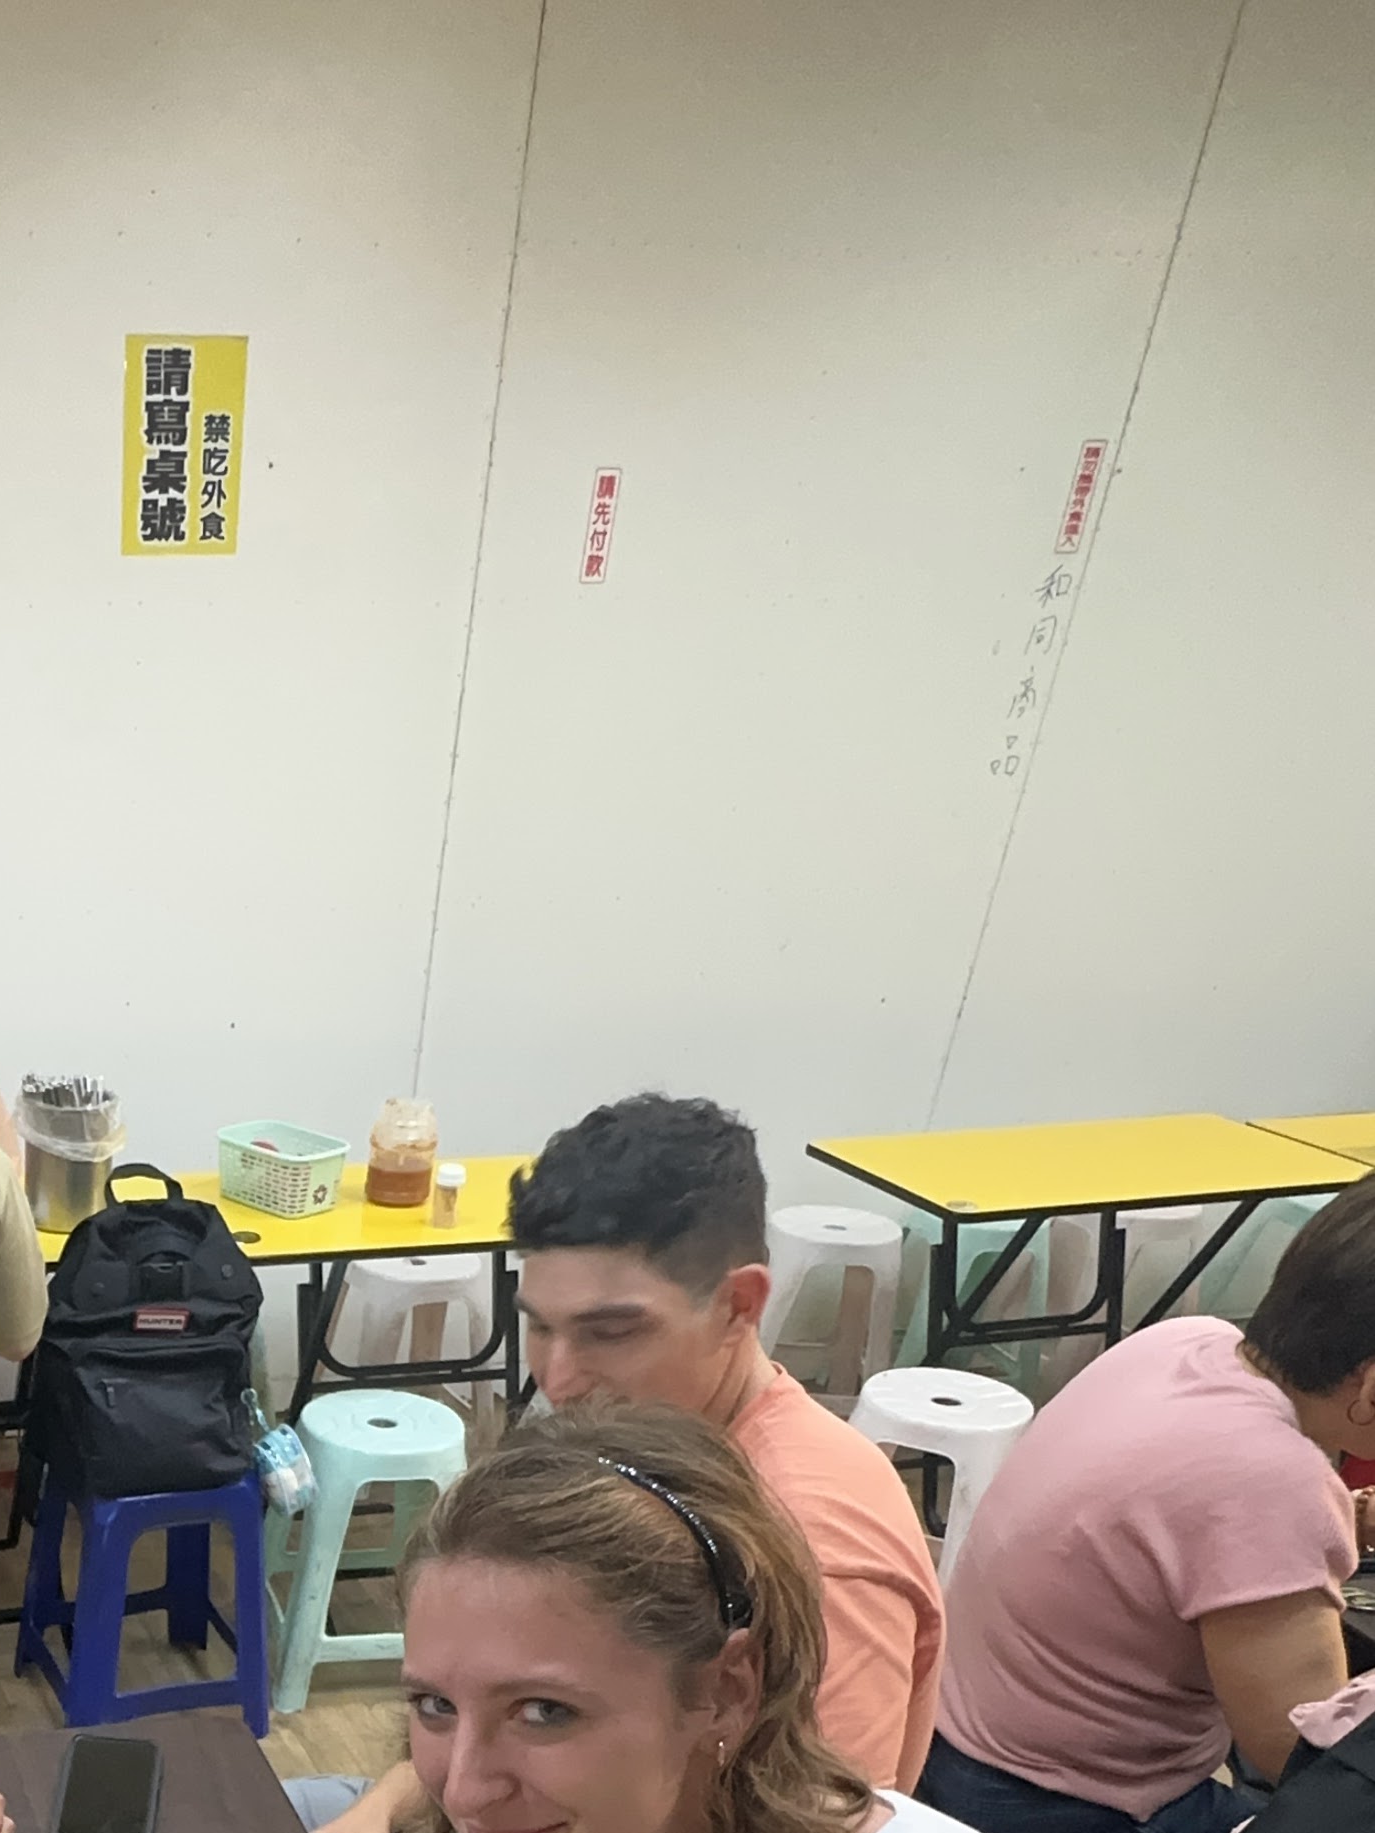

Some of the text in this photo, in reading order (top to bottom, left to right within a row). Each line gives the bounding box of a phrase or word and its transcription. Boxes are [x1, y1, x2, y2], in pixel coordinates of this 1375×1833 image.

[141, 348, 191, 542] 請寫桌號
[199, 413, 231, 541] 禁吃外食
[585, 475, 616, 577] 請先付款
